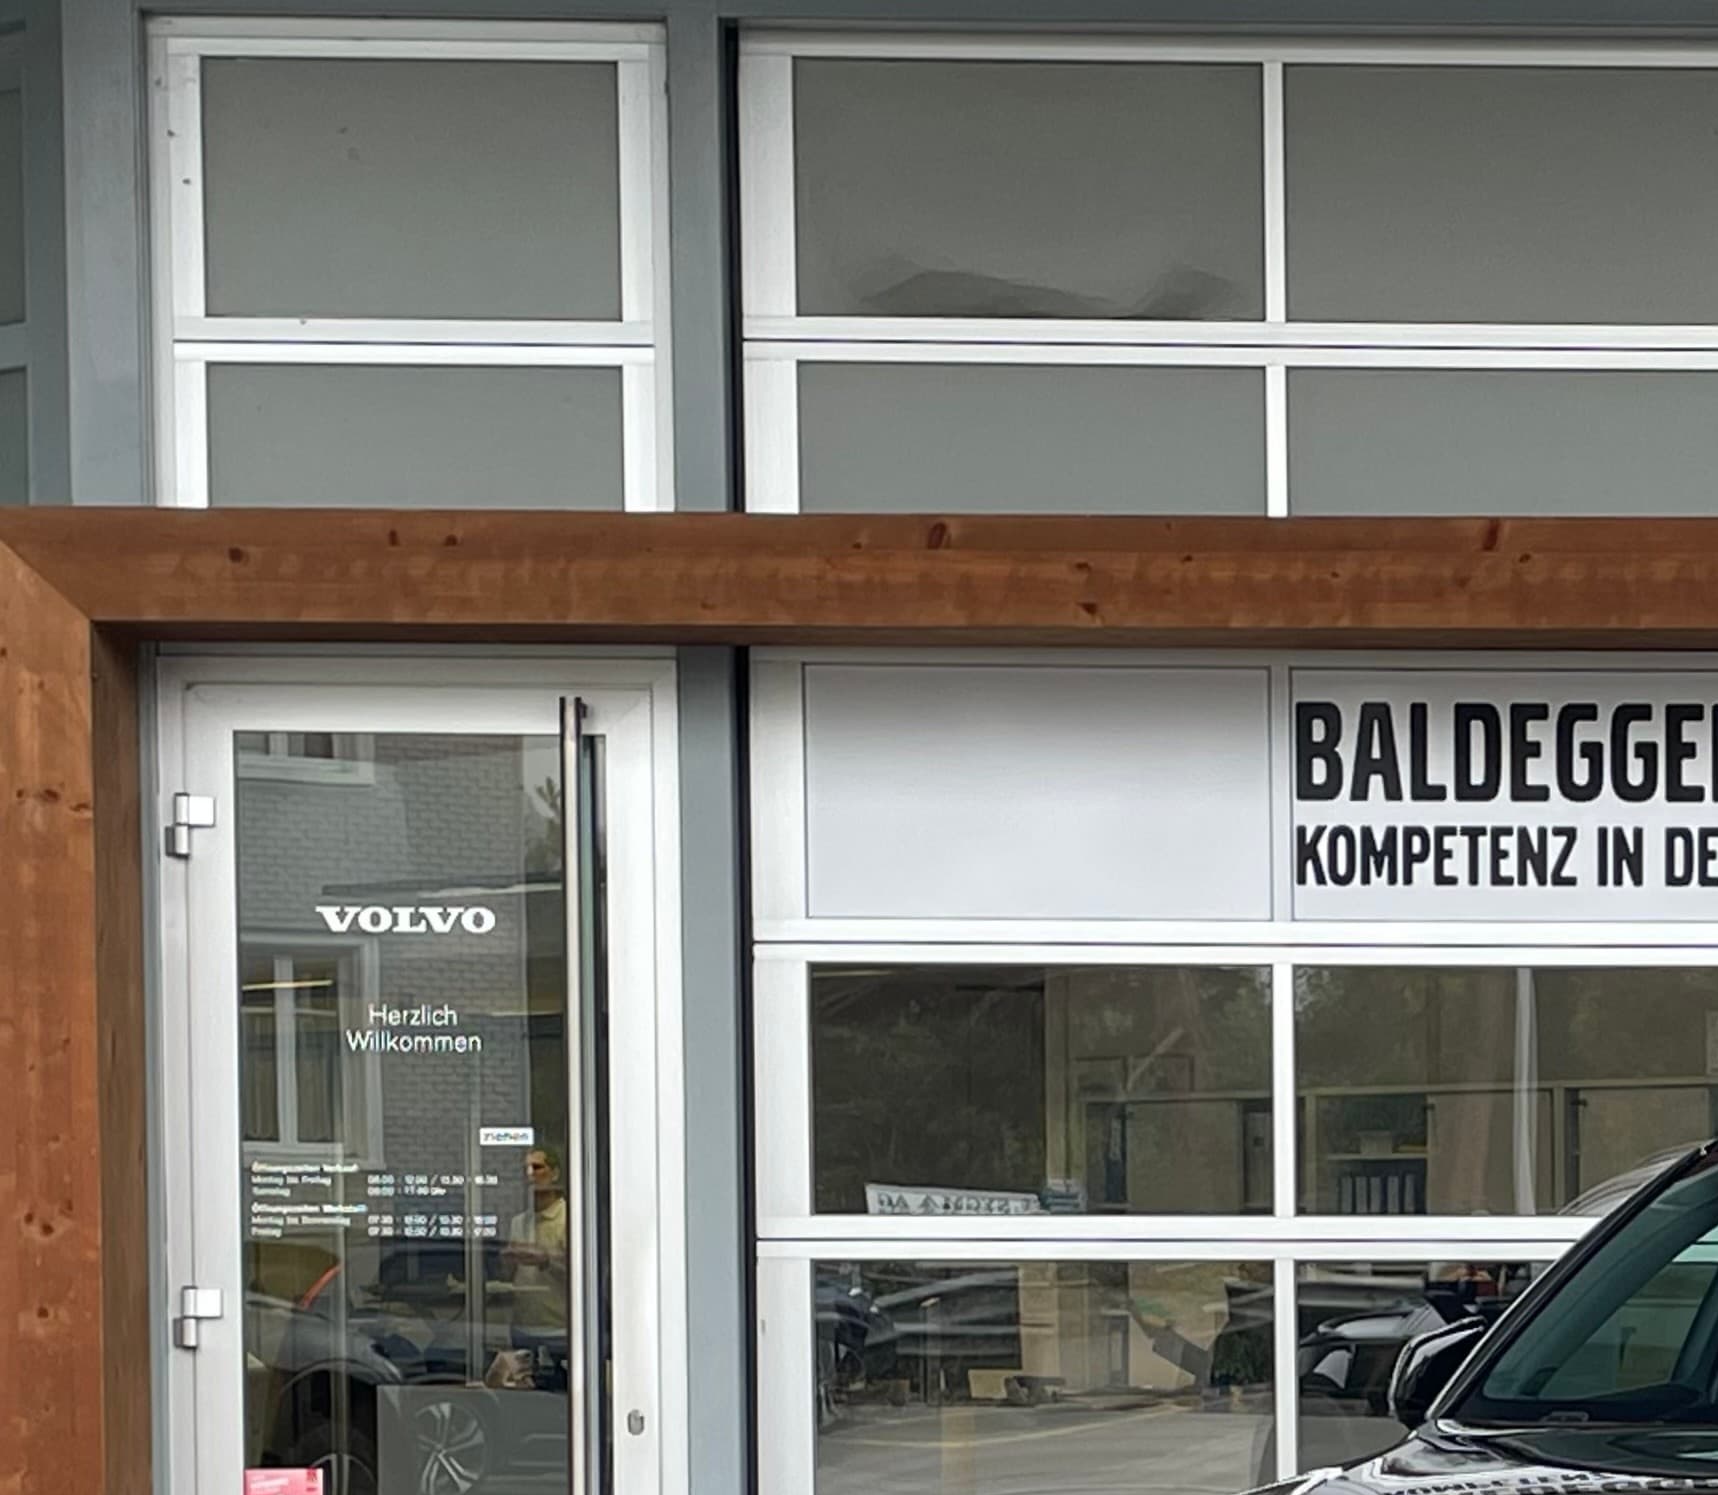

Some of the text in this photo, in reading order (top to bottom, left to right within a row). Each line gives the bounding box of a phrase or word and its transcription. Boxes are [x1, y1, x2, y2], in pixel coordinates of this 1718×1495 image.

[1296, 825, 1577, 887] KOMPETENZ
[1598, 826, 1643, 887] IN
[315, 906, 496, 934] VOLVO
[368, 1003, 458, 1026] Herzlich
[346, 1029, 482, 1053] Willkommen
